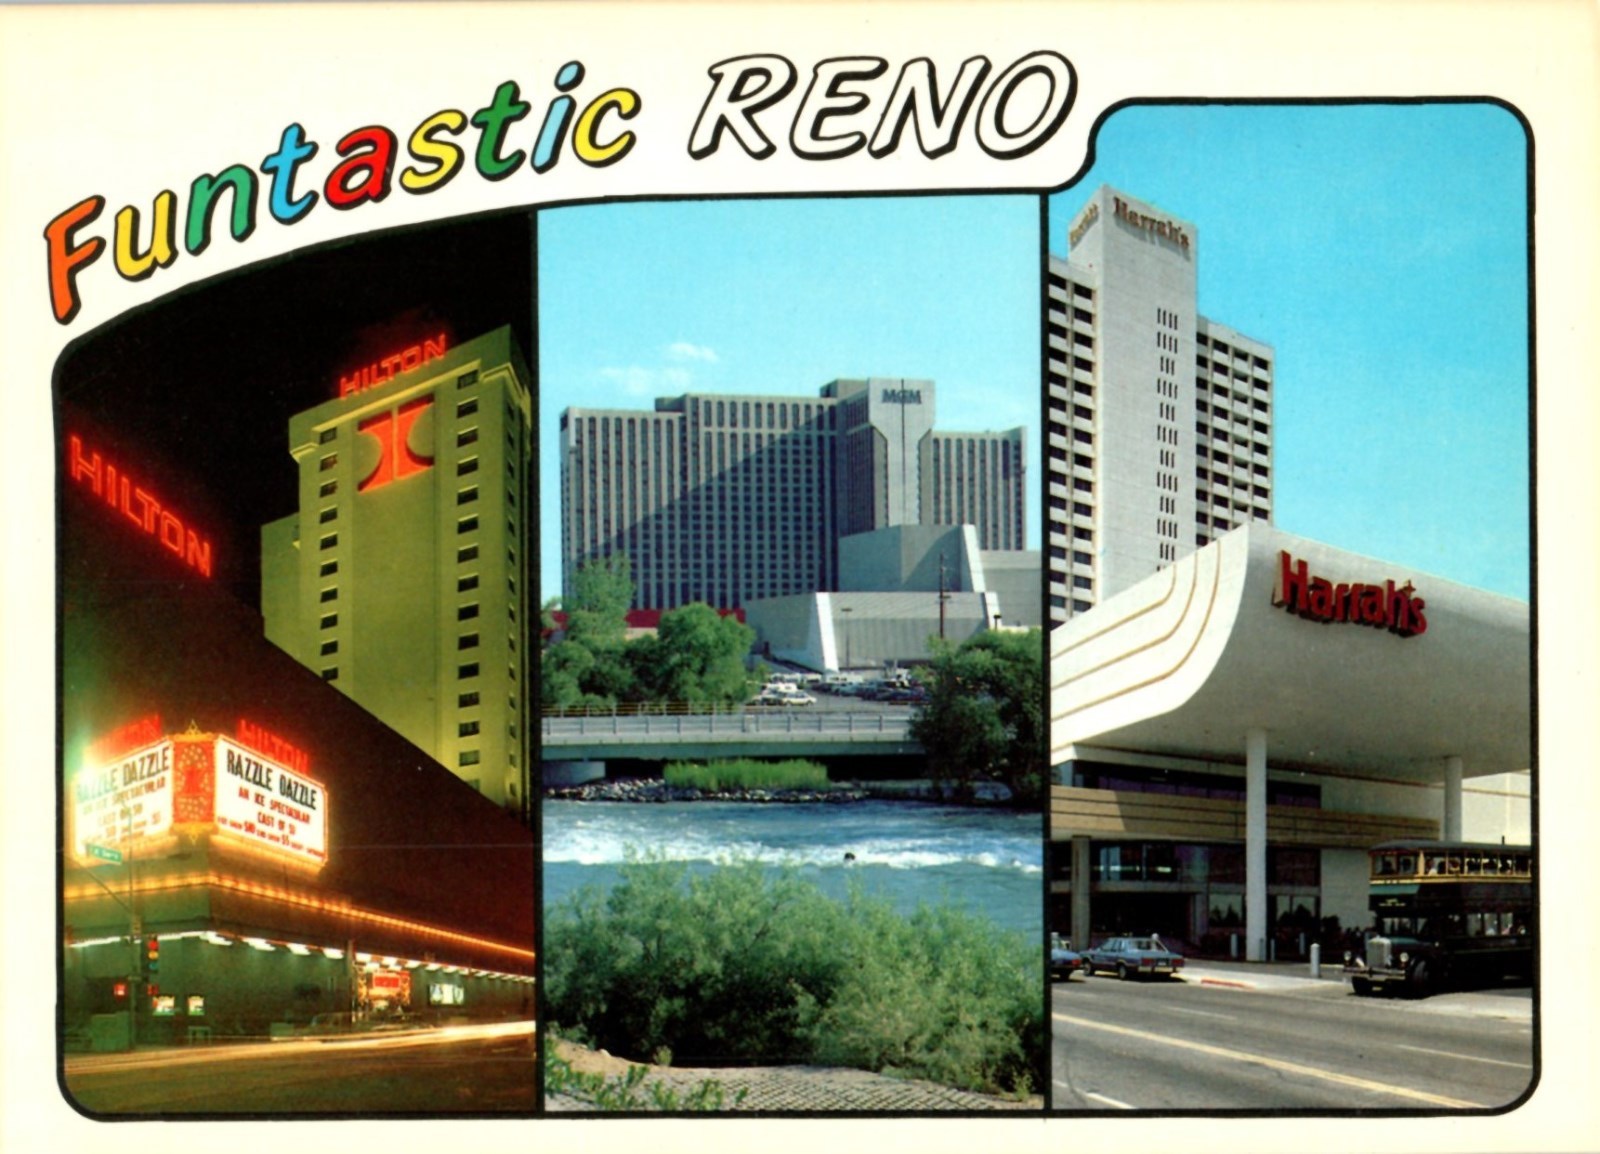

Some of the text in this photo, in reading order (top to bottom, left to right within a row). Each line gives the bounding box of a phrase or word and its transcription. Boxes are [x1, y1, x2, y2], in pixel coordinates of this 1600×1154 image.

[339, 333, 446, 399] HILTON
[882, 388, 922, 404] MGM
[70, 435, 212, 578] HILTON
[122, 746, 170, 787] DAZZLE
[237, 719, 311, 775] HILTON
[226, 748, 317, 810] RAZZLE DAZZLE
